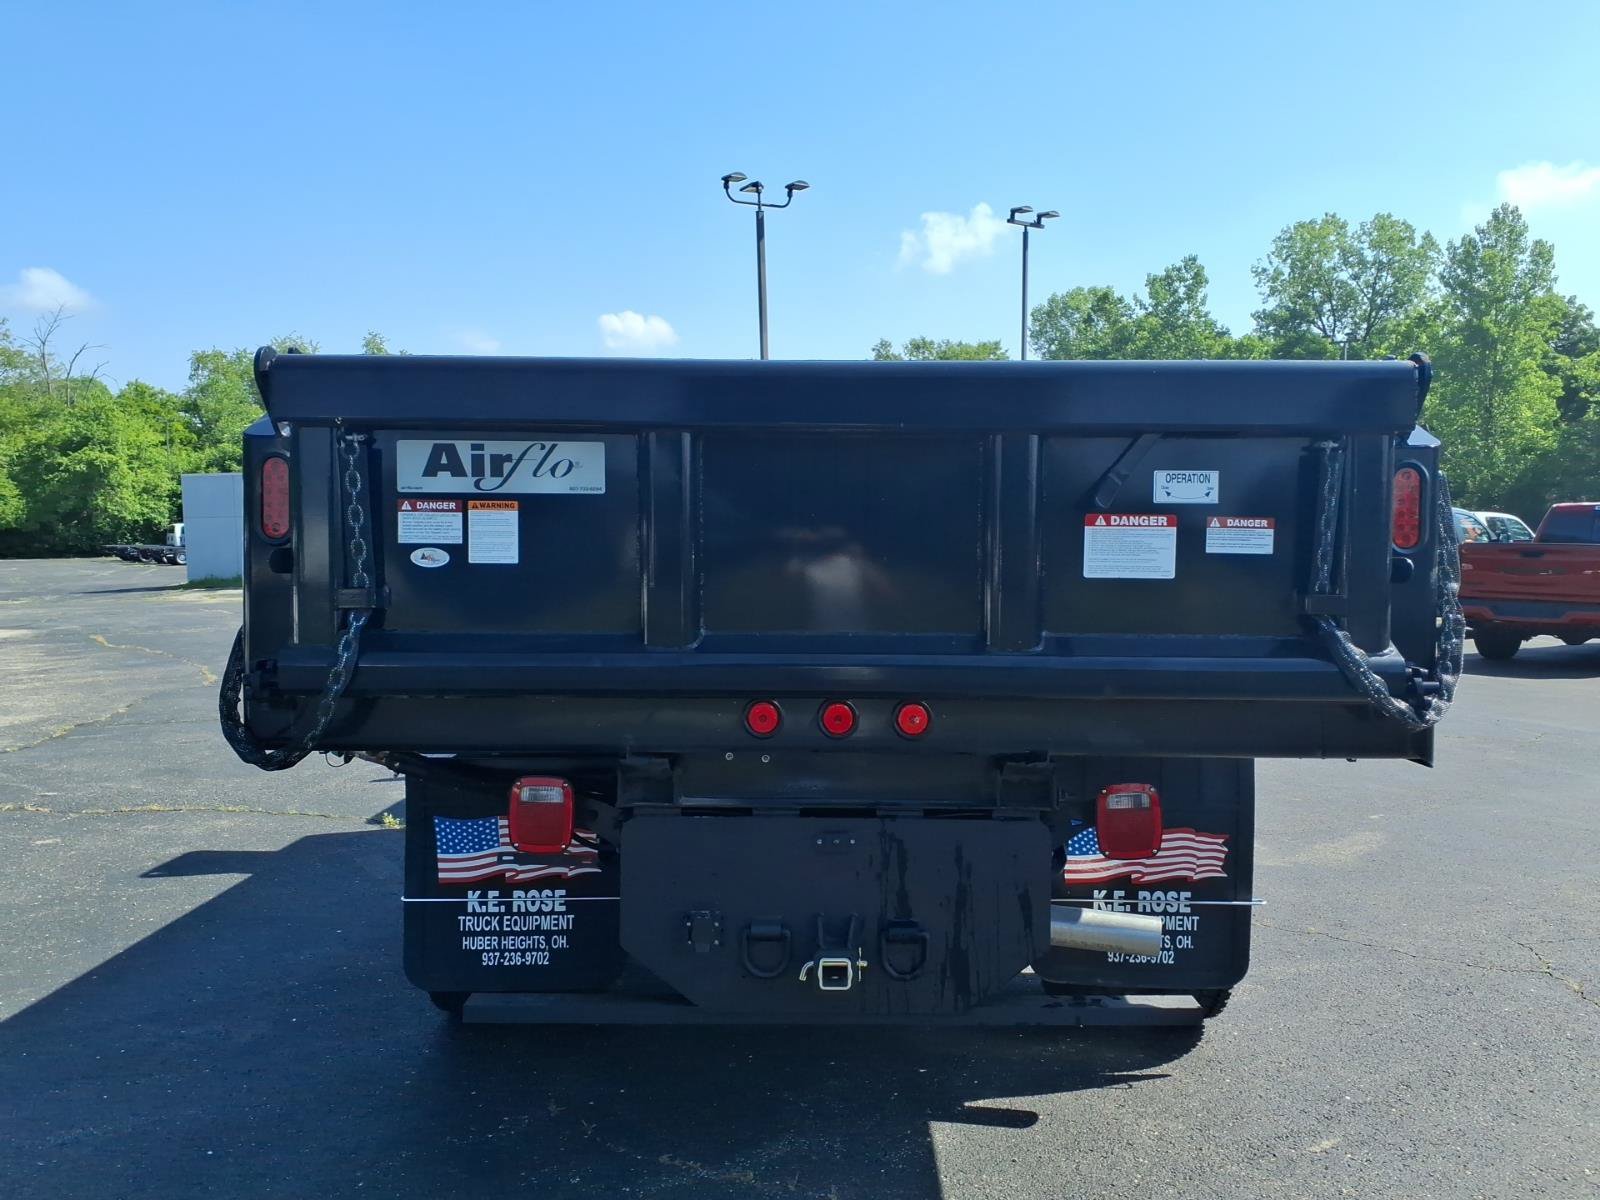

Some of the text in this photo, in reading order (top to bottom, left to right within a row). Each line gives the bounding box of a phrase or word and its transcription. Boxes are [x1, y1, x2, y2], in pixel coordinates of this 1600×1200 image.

[421, 442, 575, 491] Airflo
[1165, 473, 1211, 484] OPERATION
[416, 501, 456, 510] DANGER
[1110, 515, 1168, 526] DANGER
[1226, 519, 1269, 528] DANGER
[467, 889, 567, 913] K.E. ROSE
[1093, 889, 1192, 913] K.E. ROSE
[458, 915, 575, 931] TRUCK EQUIPMENT
[462, 935, 569, 951] HUBER HEIGHTS, OH.
[1176, 935, 1194, 949] OH.
[482, 951, 550, 966] 937-236-9702
